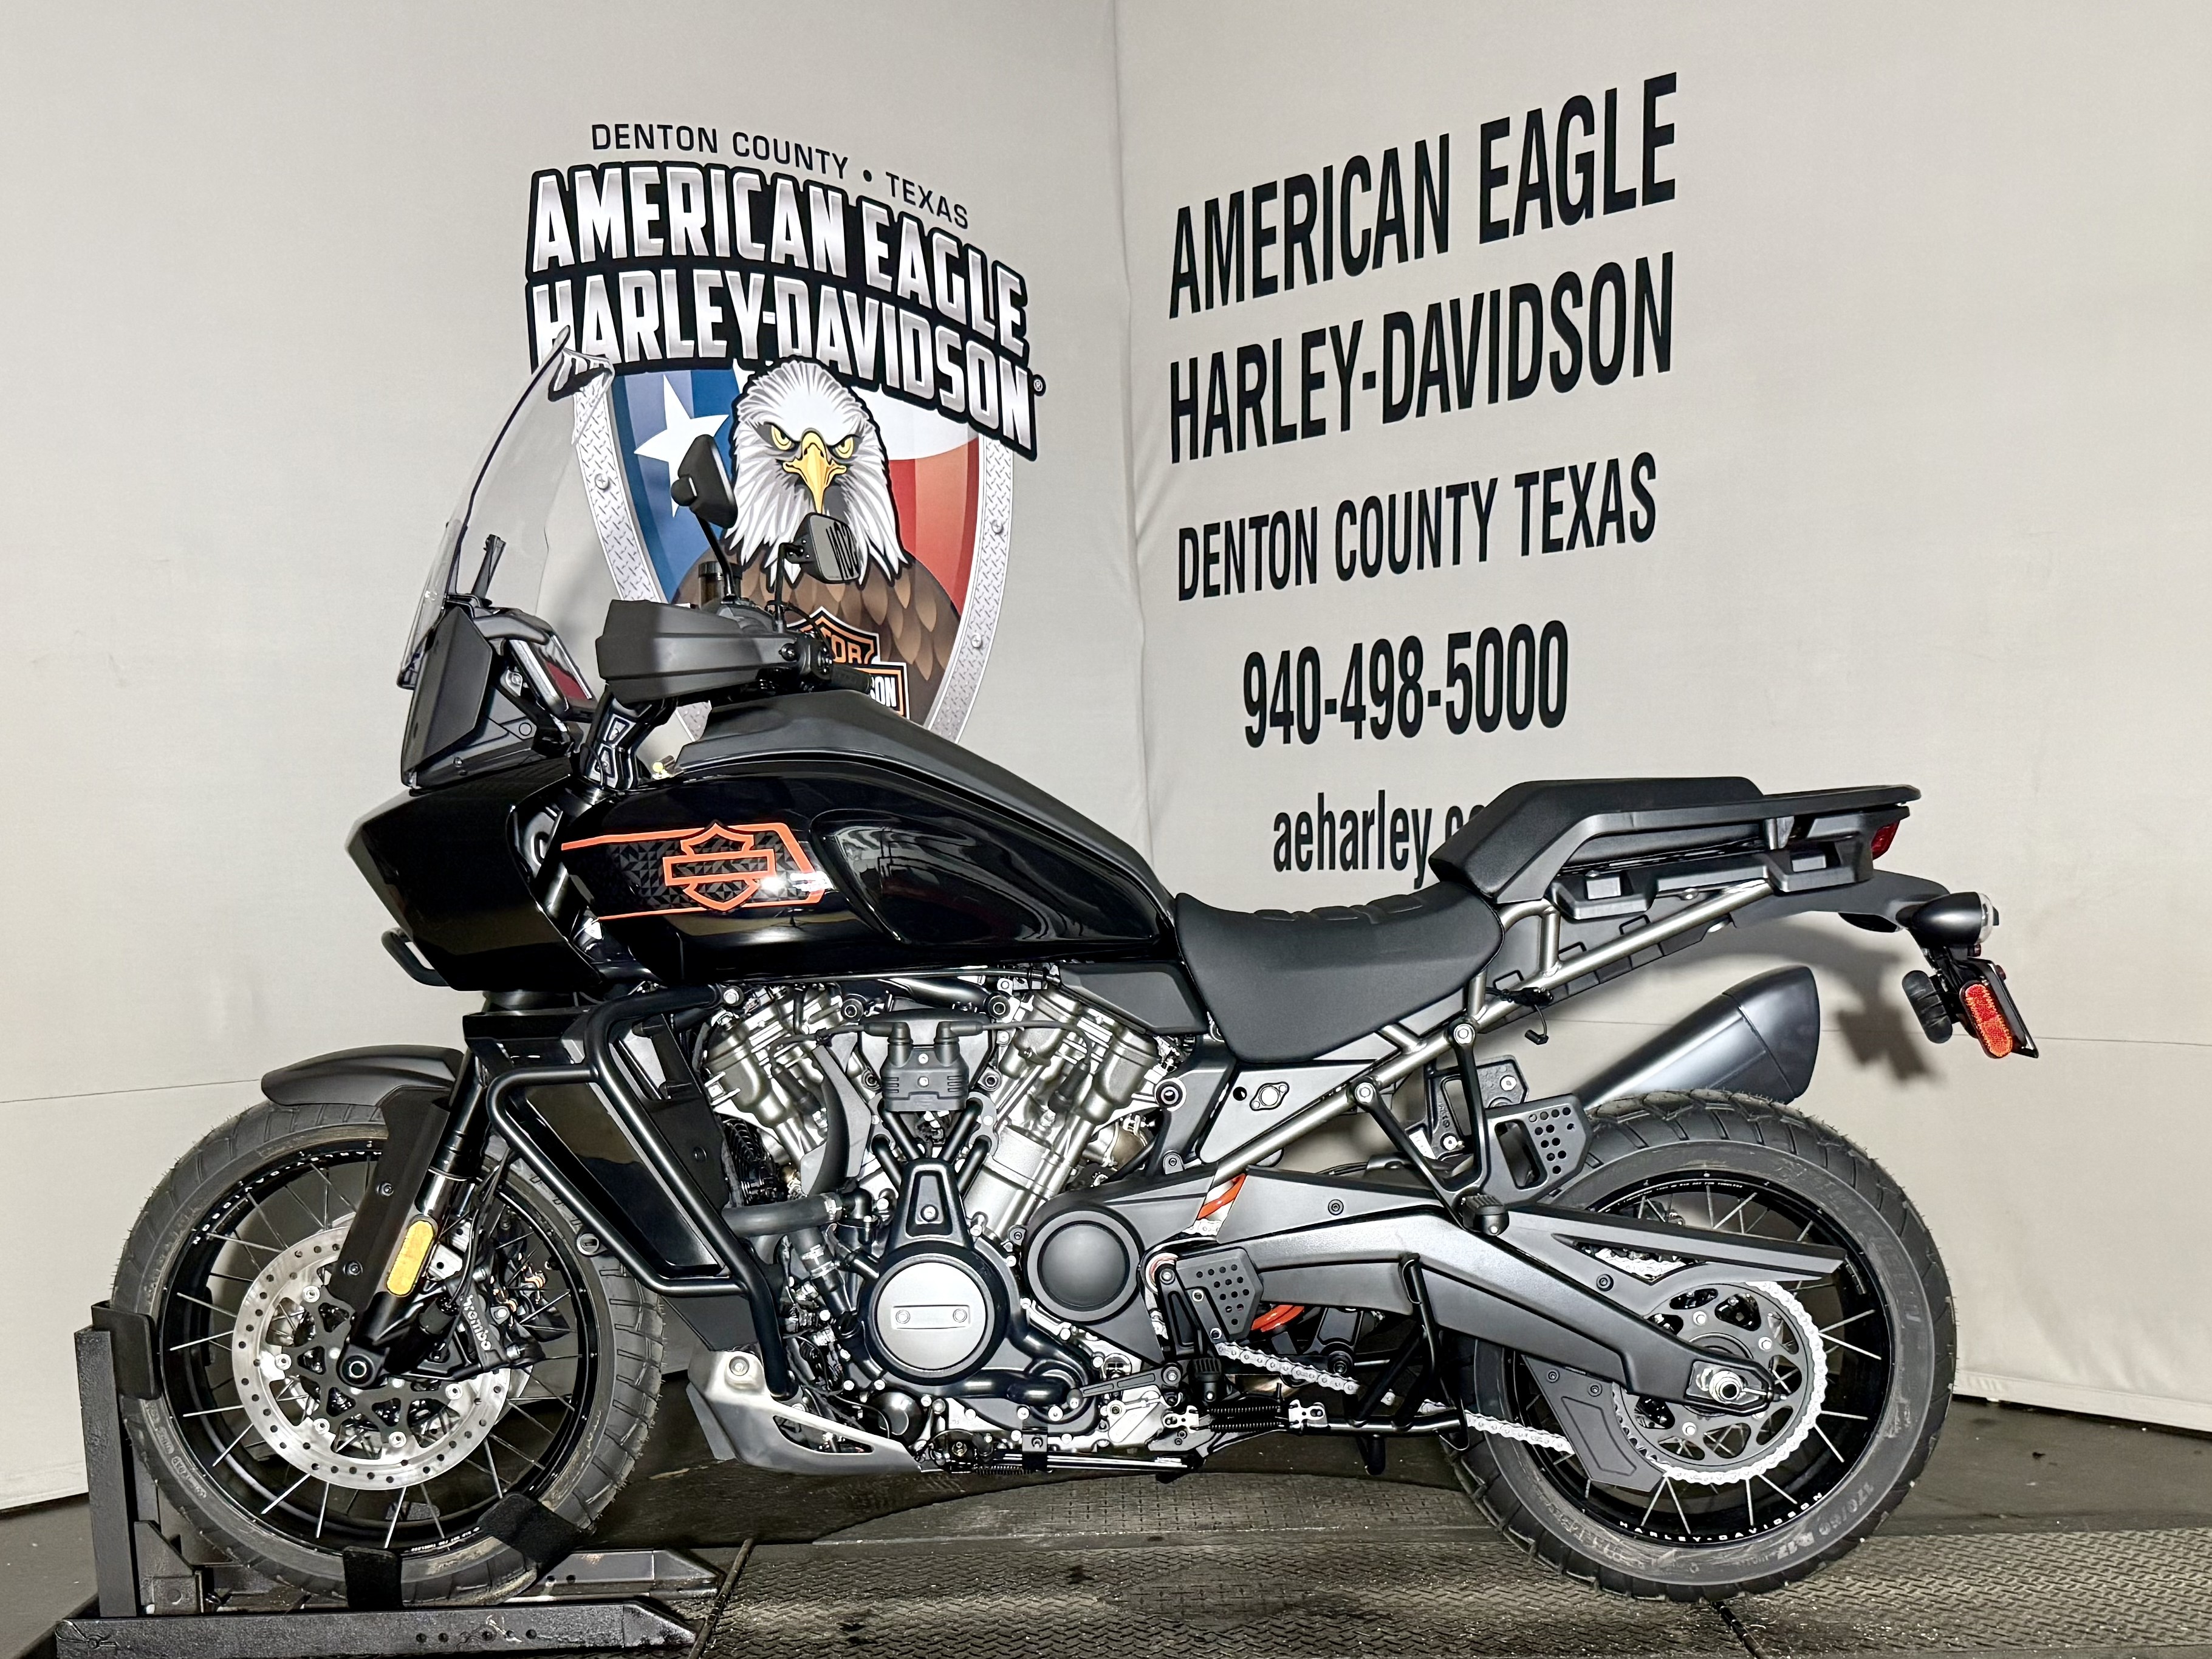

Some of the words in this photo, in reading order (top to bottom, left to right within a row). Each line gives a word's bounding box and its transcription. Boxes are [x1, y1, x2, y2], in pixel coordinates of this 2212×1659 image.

[592, 123, 717, 154] DENTON
[732, 131, 849, 179] COUNTY
[885, 171, 968, 230] TEXAS
[1169, 132, 1450, 320] AMERICAN
[1479, 72, 1677, 244] EAGLE
[532, 166, 847, 273] AMERICAN
[861, 200, 1024, 357] EAGLE
[532, 269, 1032, 450] HARLEY-DAVIDSON
[1170, 251, 1673, 464] HARLEY-DAVIDSON
[1179, 506, 1318, 601] DENTON
[1335, 477, 1498, 581] COUNTY
[1514, 451, 1656, 557] TEXAS
[1243, 620, 1568, 748] 940-498-5000
[1620, 1492, 1823, 1542] HARLEY-DAVIDSON
